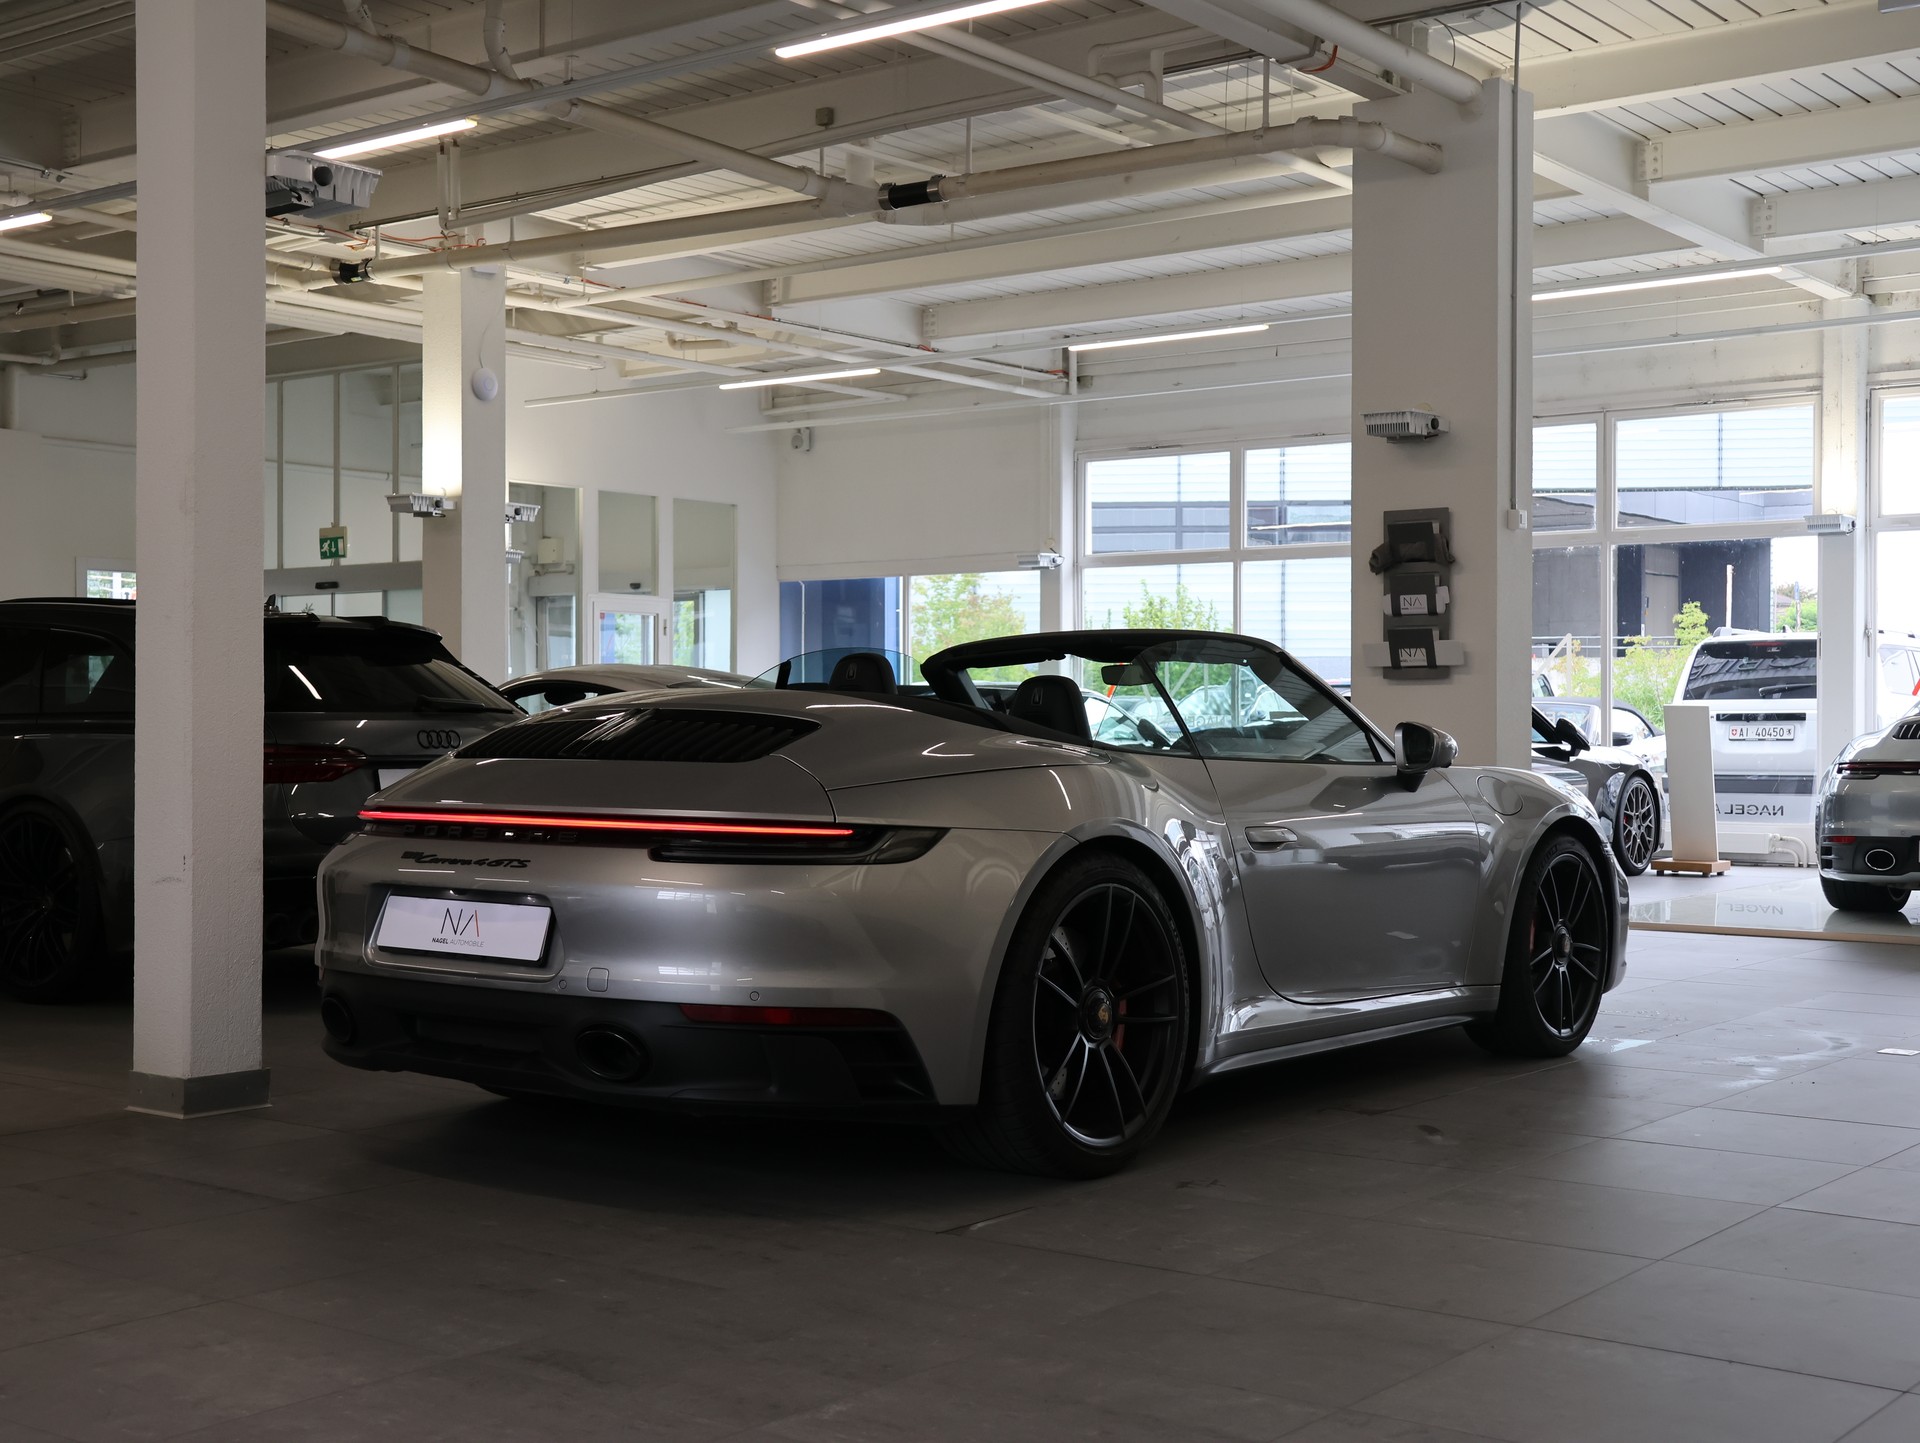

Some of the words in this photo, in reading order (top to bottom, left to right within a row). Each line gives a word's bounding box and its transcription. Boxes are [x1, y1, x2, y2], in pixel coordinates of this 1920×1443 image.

[1403, 597, 1422, 607] NA
[1739, 727, 1749, 737] AI
[1755, 727, 1785, 738] 40450
[402, 824, 578, 843] PORSCHE
[414, 854, 472, 866] Carrera
[486, 859, 532, 869] GTS
[432, 937, 449, 945] NAGEL
[450, 938, 485, 948] AUTOMOBILE
